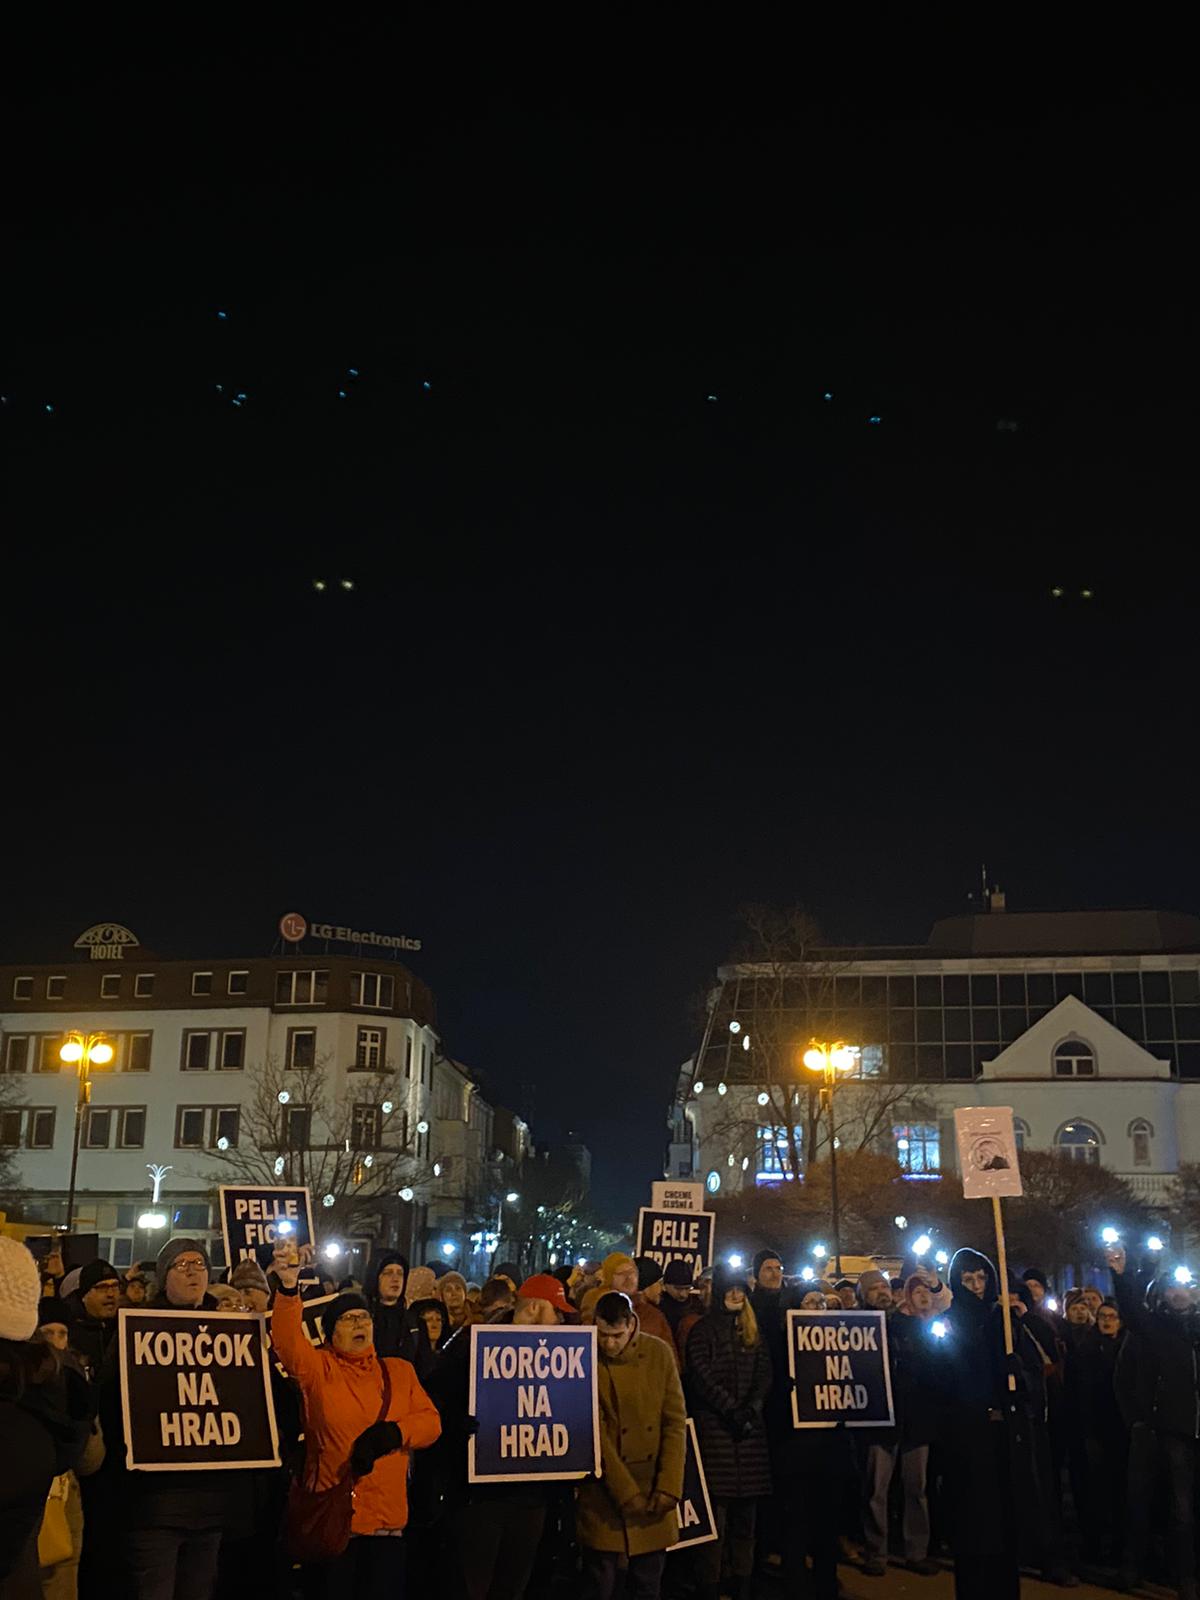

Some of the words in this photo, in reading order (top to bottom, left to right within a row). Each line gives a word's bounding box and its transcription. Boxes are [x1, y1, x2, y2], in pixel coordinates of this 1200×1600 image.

[310, 922, 333, 939] LG
[335, 926, 422, 951] Electronics
[90, 944, 124, 960] HOTEL
[234, 1199, 298, 1220] PELLE
[244, 1223, 284, 1245] FIC
[652, 1218, 700, 1249] PELLE
[134, 1325, 255, 1367] KORČOK
[797, 1321, 878, 1351] KORČOK
[483, 1339, 585, 1379] KORČOK
[826, 1355, 853, 1380] NA
[177, 1372, 219, 1406] NA
[517, 1385, 552, 1418] NA
[815, 1384, 868, 1410] HRAD
[160, 1412, 241, 1446] HRAD
[501, 1424, 569, 1458] HRAD
